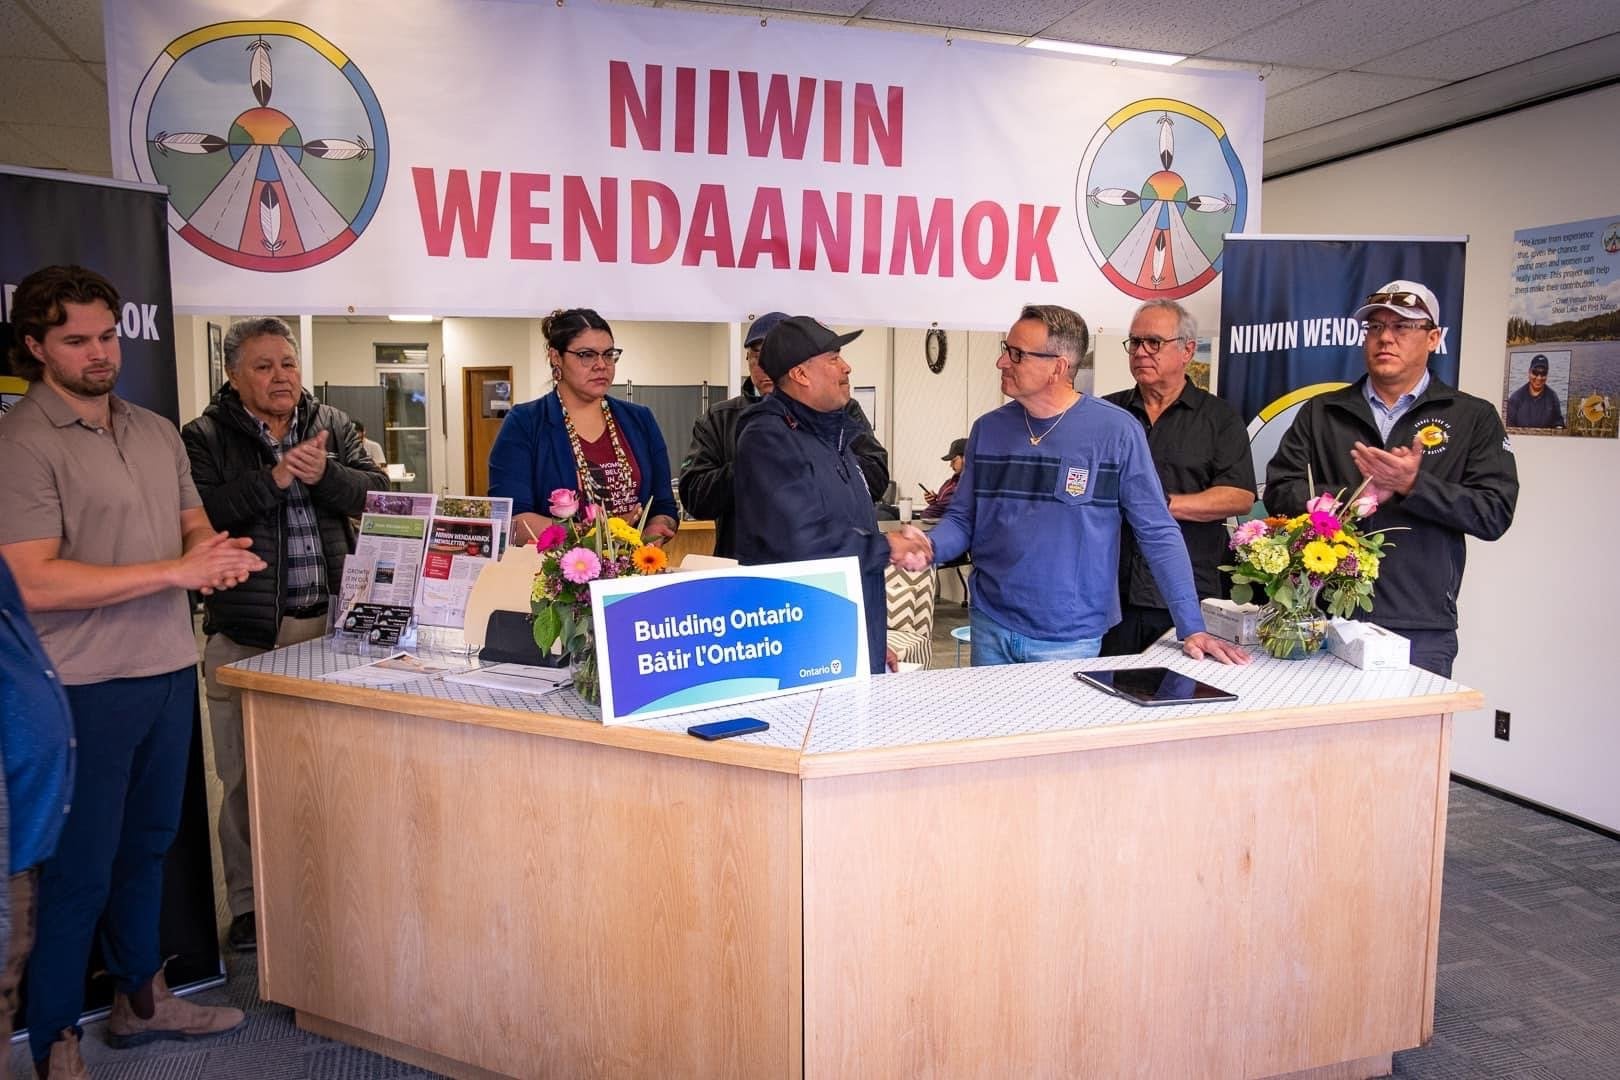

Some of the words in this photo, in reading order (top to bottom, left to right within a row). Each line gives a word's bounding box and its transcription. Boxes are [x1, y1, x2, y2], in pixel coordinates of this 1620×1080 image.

[609, 60, 904, 167] NIIWIN
[411, 166, 1061, 283] WENDAANIMOK
[1562, 231, 1594, 242] experience
[1530, 249, 1546, 258] given
[1547, 247, 1556, 255] the
[1516, 263, 1533, 272] young
[1534, 261, 1547, 269] men
[1548, 258, 1559, 267] and
[1560, 257, 1583, 266] women
[1583, 255, 1594, 263] can
[1550, 271, 1561, 279] This
[1562, 269, 1583, 279] project
[1584, 266, 1595, 275] will
[1596, 265, 1610, 275] help
[1515, 286, 1529, 294] them
[1530, 284, 1545, 293] make
[1546, 282, 1558, 291] their
[1566, 304, 1578, 313] Lake
[1580, 304, 1587, 312] 40
[1587, 302, 1599, 312] First
[1600, 301, 1618, 311] Nation
[1230, 320, 1298, 354] NIIWIN
[634, 614, 726, 642] Building
[730, 603, 804, 630] Ontario
[637, 652, 692, 676] Bâtir
[696, 636, 783, 667] l'Ontario
[799, 665, 830, 679] Ontario
